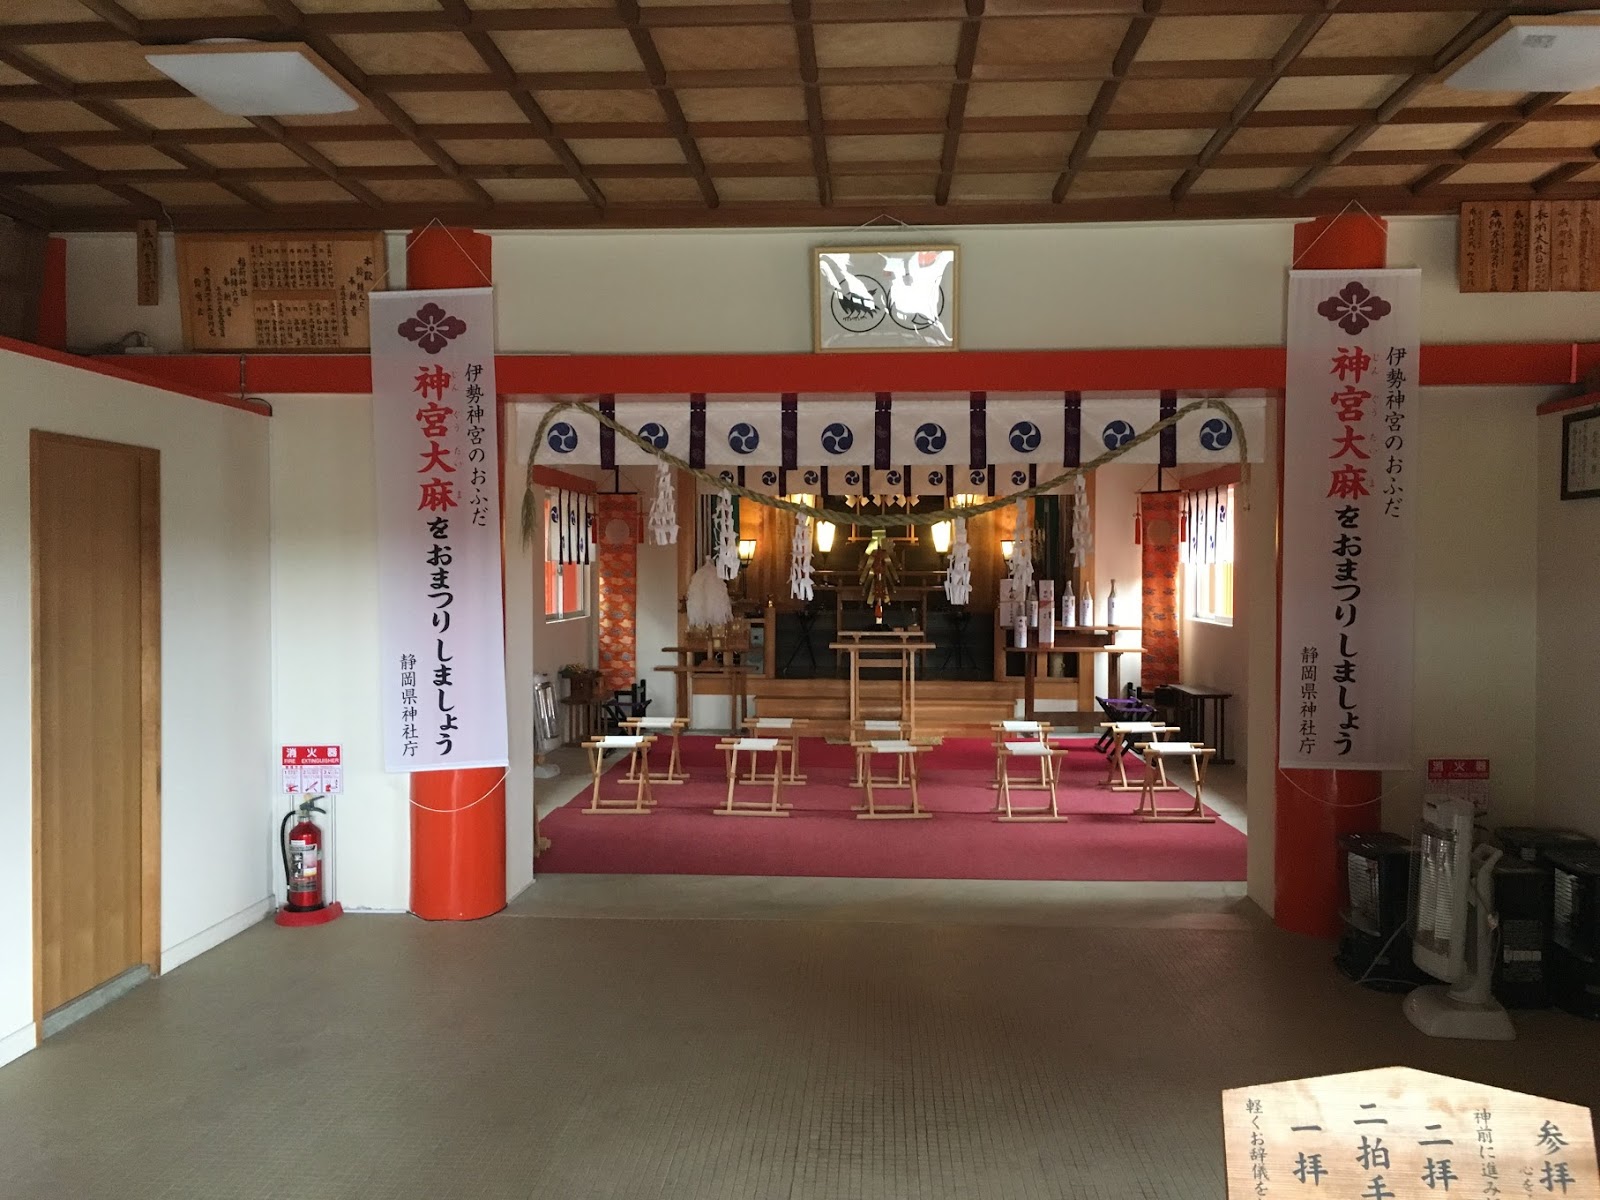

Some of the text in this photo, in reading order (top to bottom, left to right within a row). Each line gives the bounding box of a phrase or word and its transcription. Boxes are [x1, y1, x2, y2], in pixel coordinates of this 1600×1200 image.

[465, 363, 489, 526] 伊勢神宮のおふだ
[1383, 346, 1408, 518] 伊勢神宮のおふだ
[399, 653, 419, 757] 静岡県神社庁
[1299, 646, 1318, 754] 静岡県神社庁
[286, 747, 337, 758] 消火器
[1290, 1122, 1329, 1187] 一拝
[1353, 1103, 1396, 1200] 二拍手
[1418, 1123, 1459, 1192] 二拝
[1473, 1108, 1503, 1200] 神前に進み
[1535, 1119, 1576, 1195] 参拝
